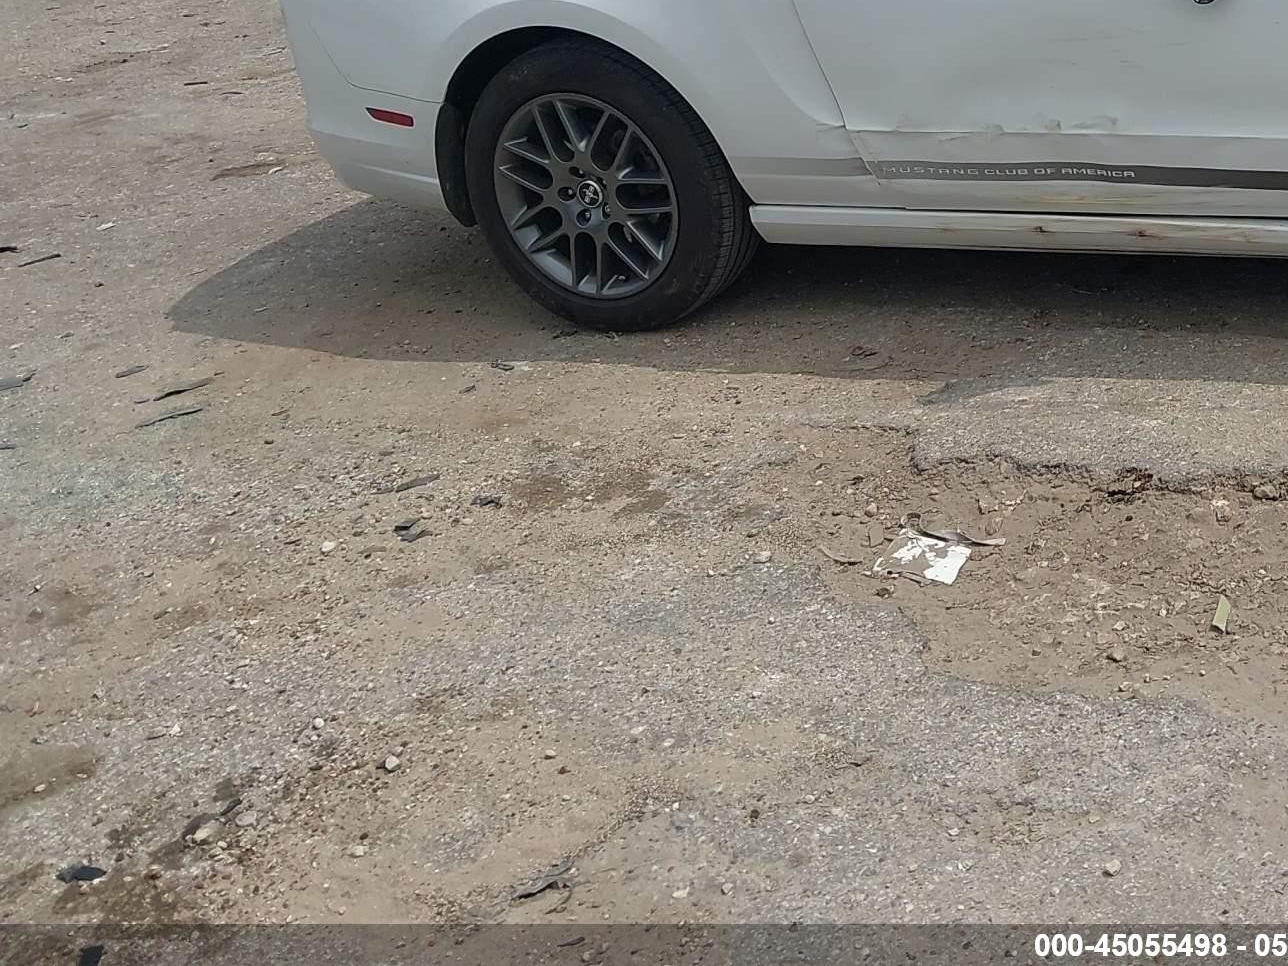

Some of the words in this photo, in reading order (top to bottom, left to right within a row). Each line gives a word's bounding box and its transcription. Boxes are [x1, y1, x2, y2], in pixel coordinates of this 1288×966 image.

[881, 166, 980, 175] MUSTANG
[983, 168, 1029, 176] CLUB
[1060, 167, 1137, 178] AMERICA
